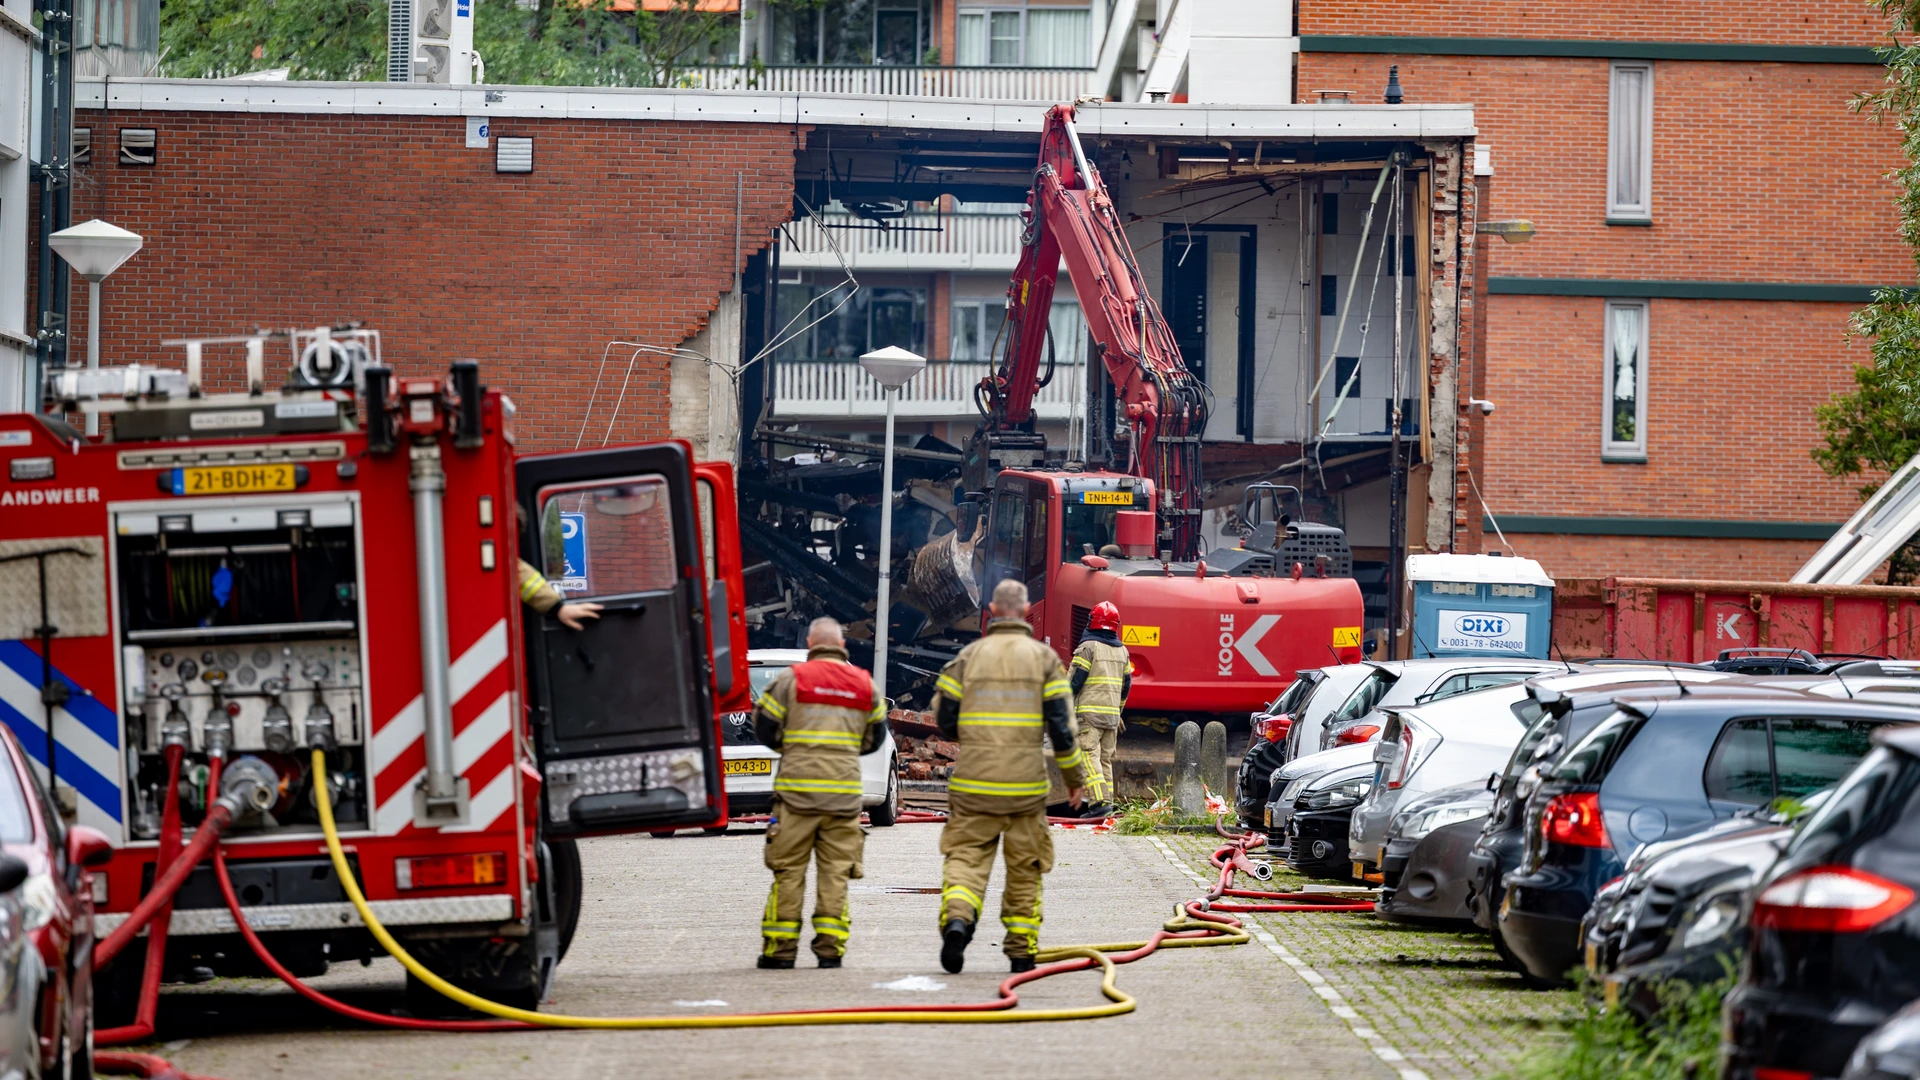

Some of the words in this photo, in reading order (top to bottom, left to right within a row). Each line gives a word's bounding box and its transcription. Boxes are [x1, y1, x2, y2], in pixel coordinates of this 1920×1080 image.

[192, 468, 287, 490] 21-BDH-2
[0, 487, 100, 507] ANDWEER
[1088, 493, 1130, 503] TNH-14-N
[1716, 612, 1724, 639] KOOLE
[1218, 613, 1234, 676] KOOLE
